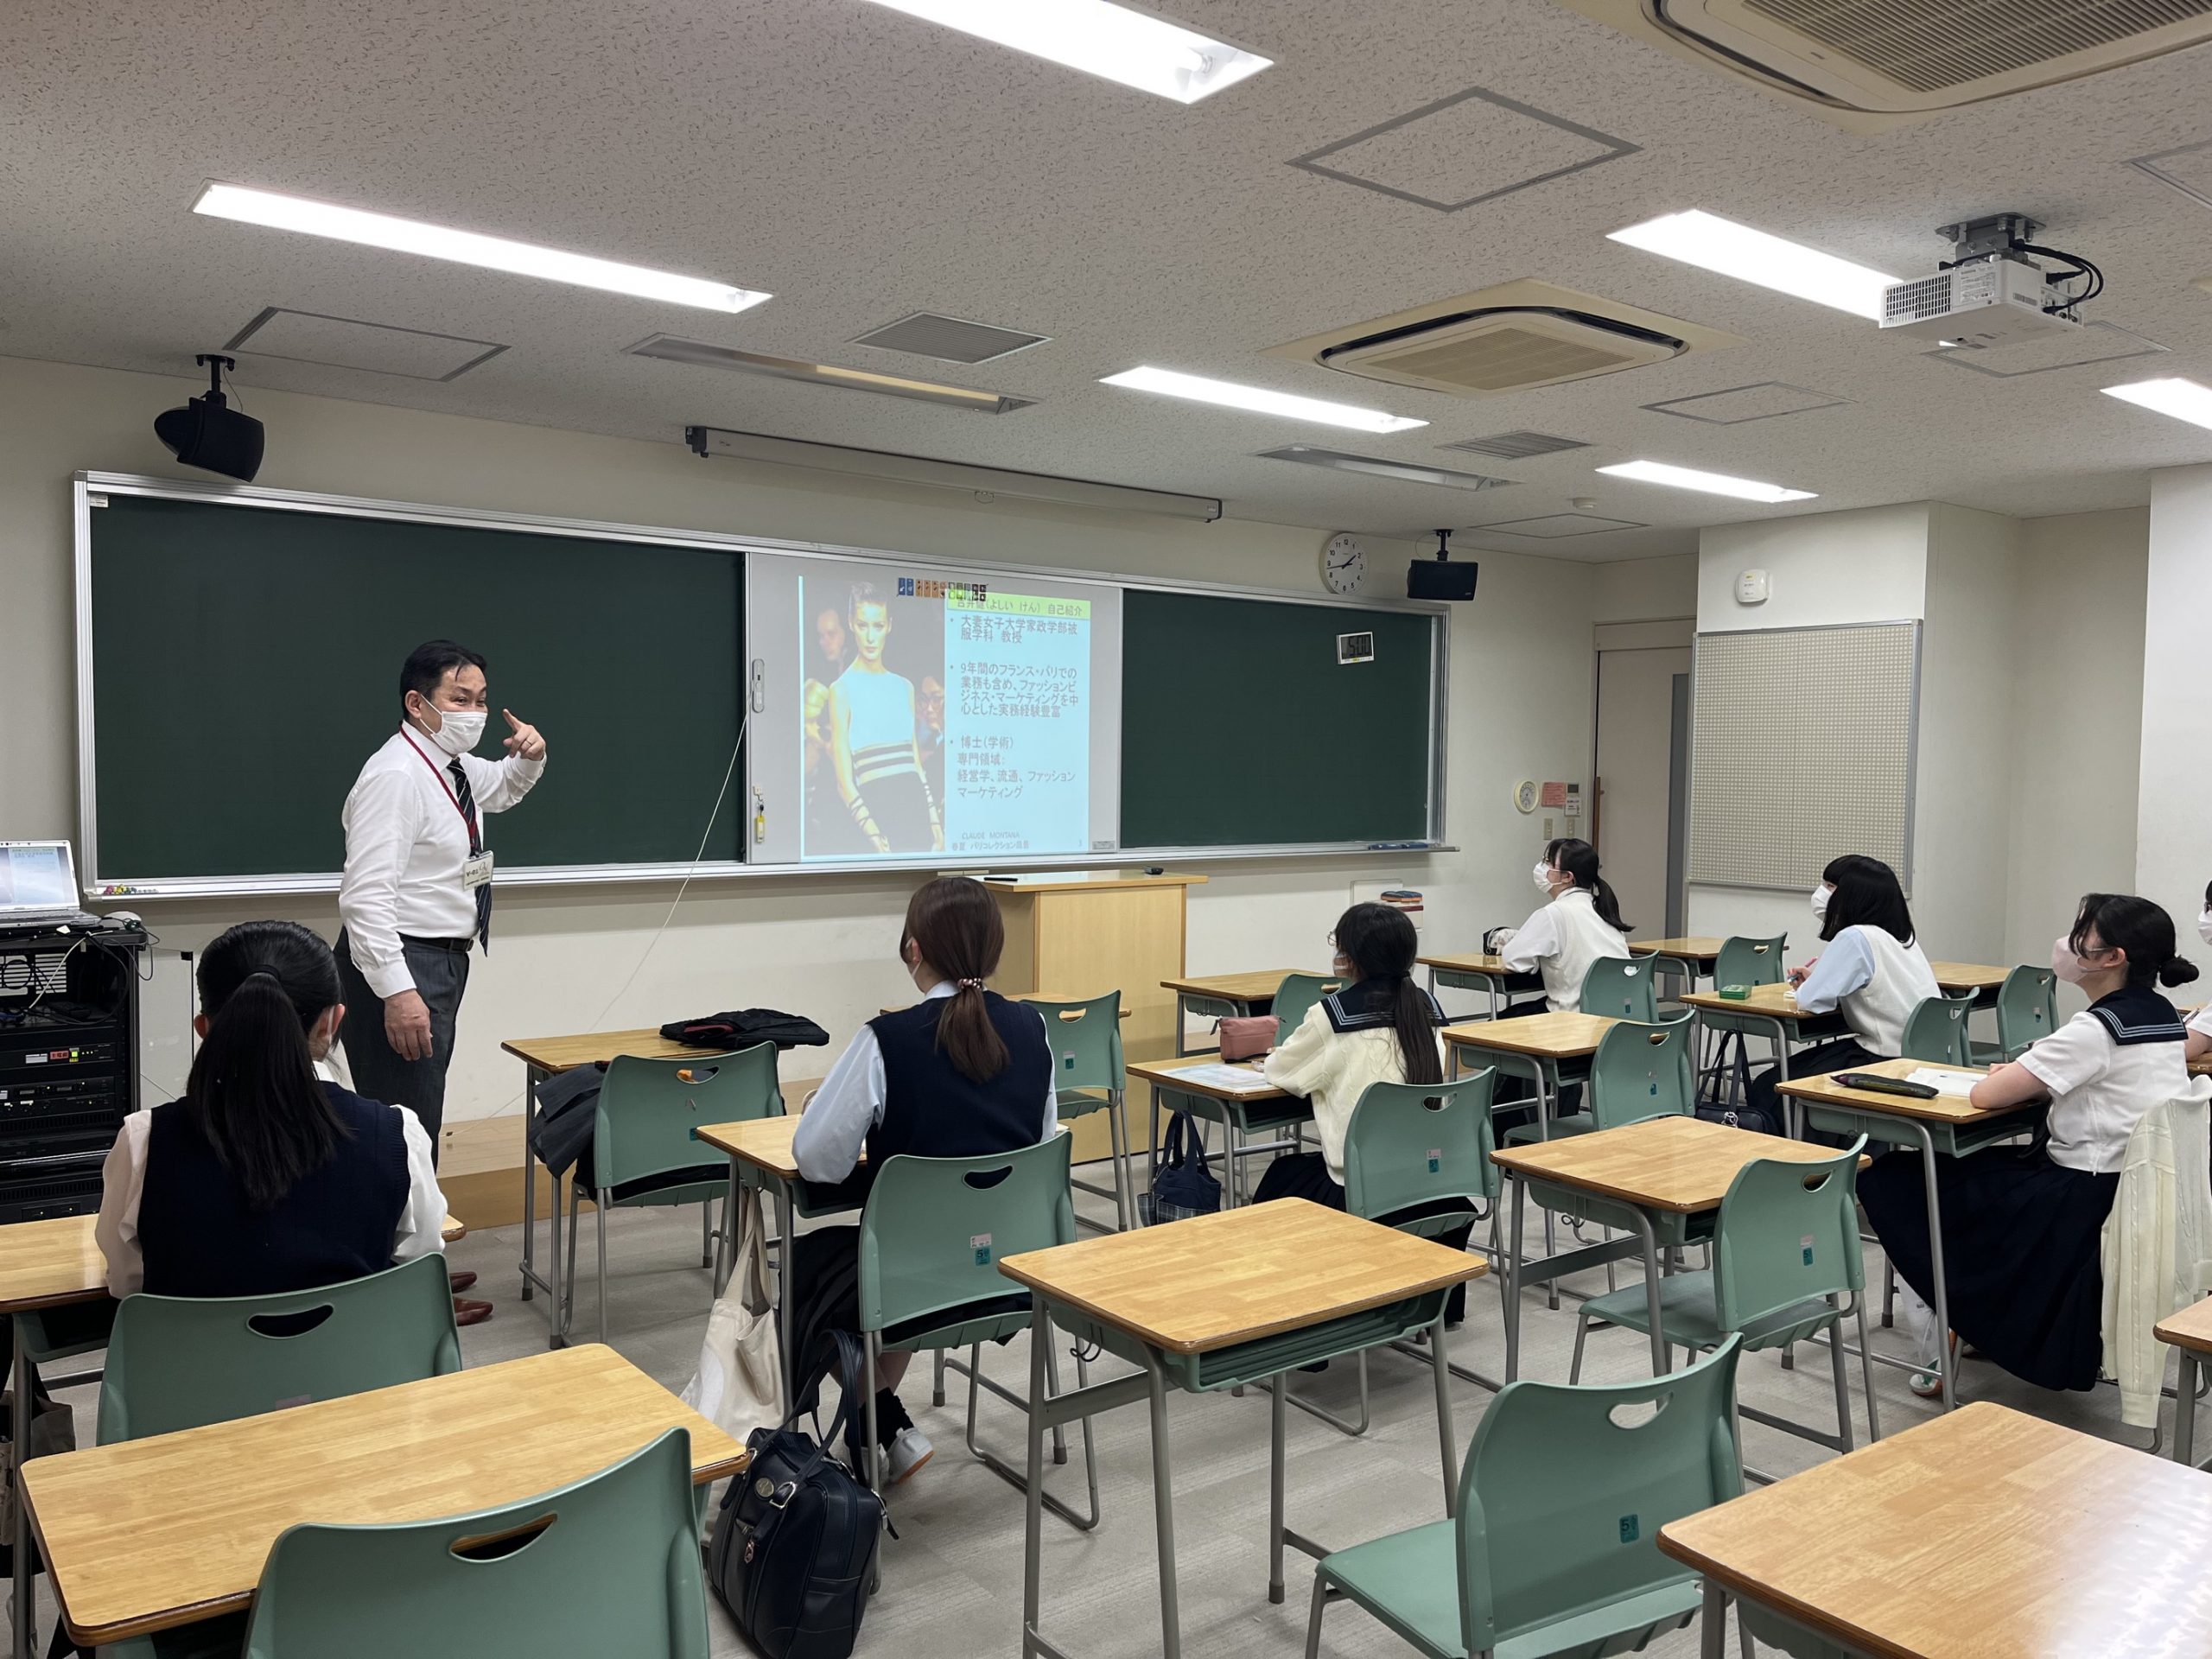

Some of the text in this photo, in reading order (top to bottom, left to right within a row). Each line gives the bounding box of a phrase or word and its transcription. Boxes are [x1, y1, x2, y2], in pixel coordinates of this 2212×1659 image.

[957, 785, 1023, 799] マーケティング
